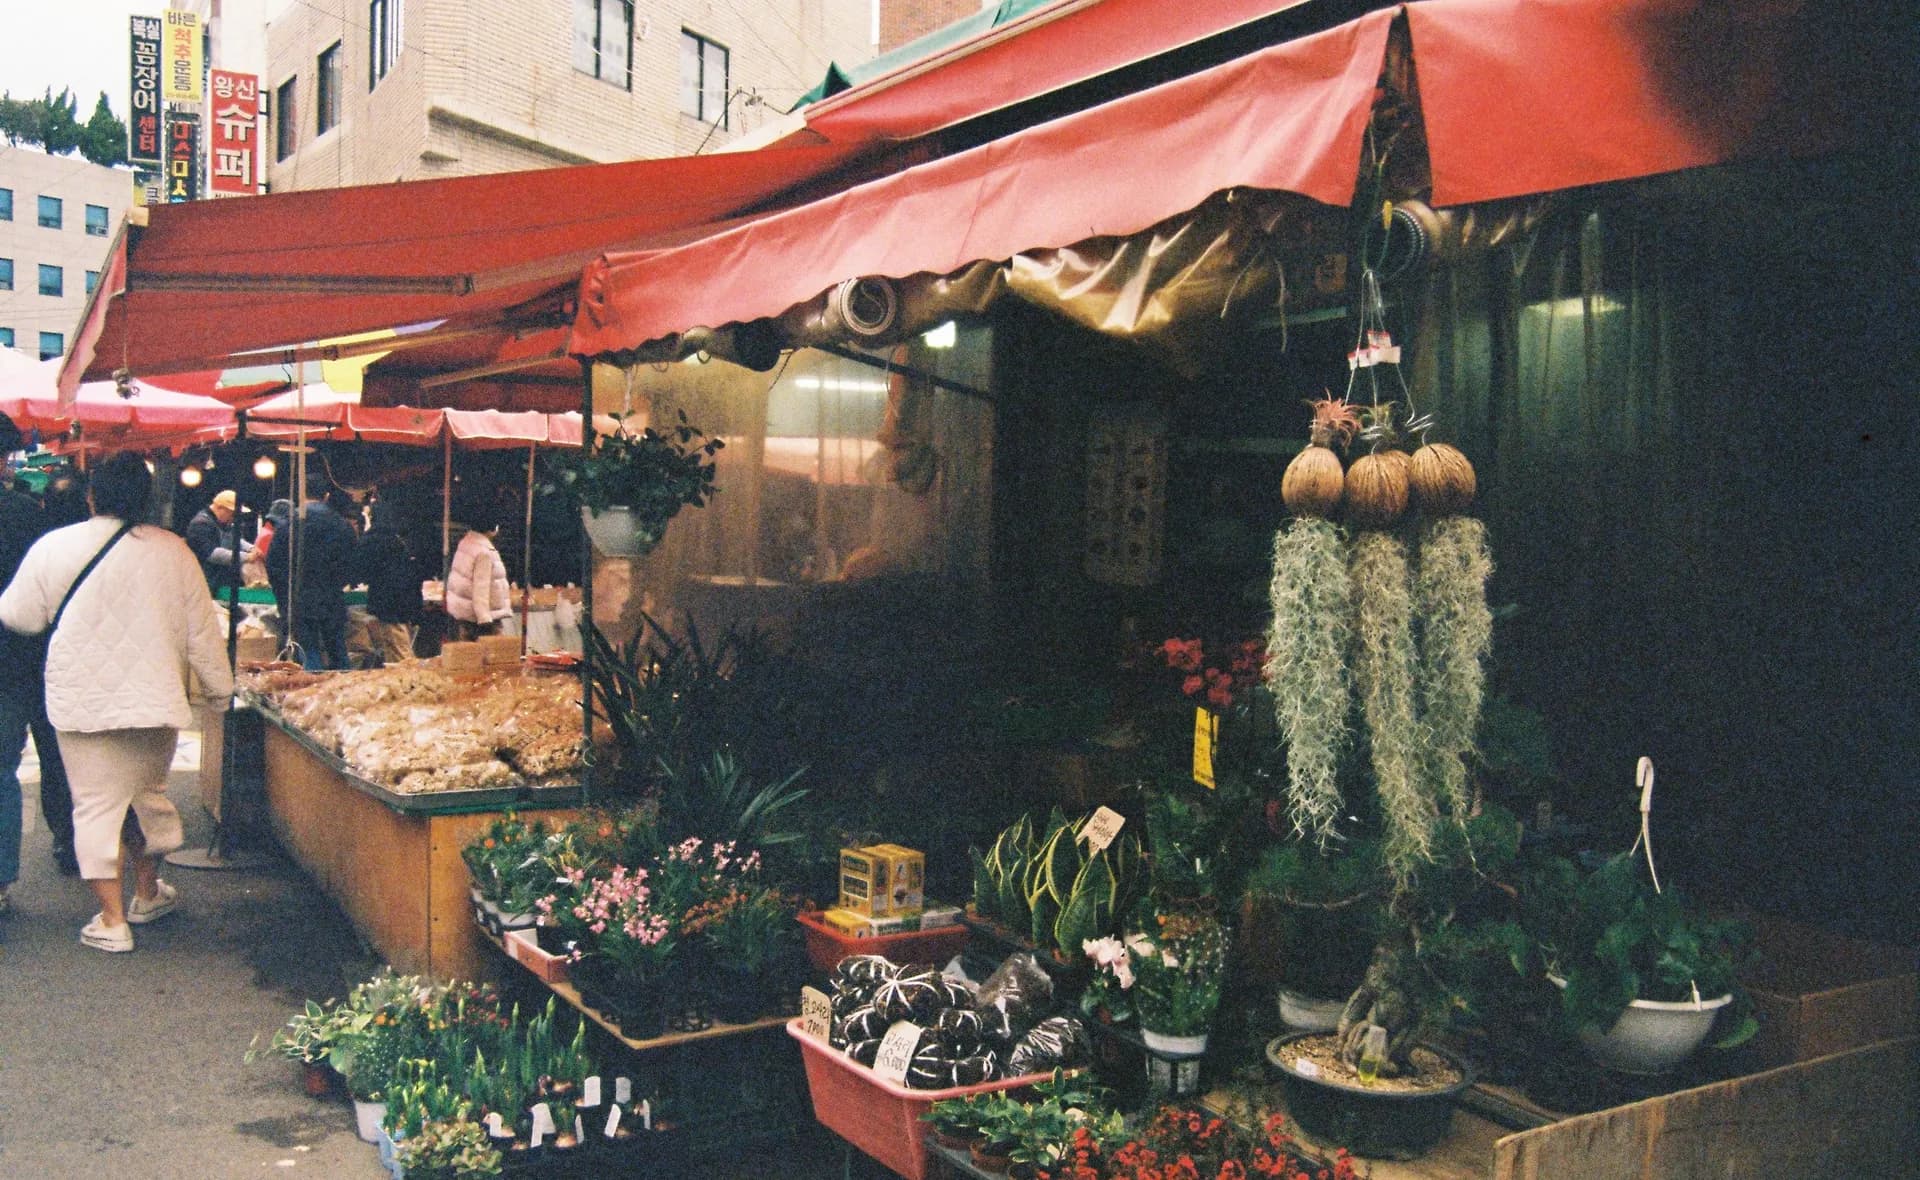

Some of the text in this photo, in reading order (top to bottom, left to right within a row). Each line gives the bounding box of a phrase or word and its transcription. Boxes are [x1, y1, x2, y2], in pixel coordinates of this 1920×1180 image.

[168, 12, 196, 27] 바른
[214, 76, 256, 101] 왕신
[139, 116, 157, 153] 센터
[215, 103, 256, 186] 슈퍼
